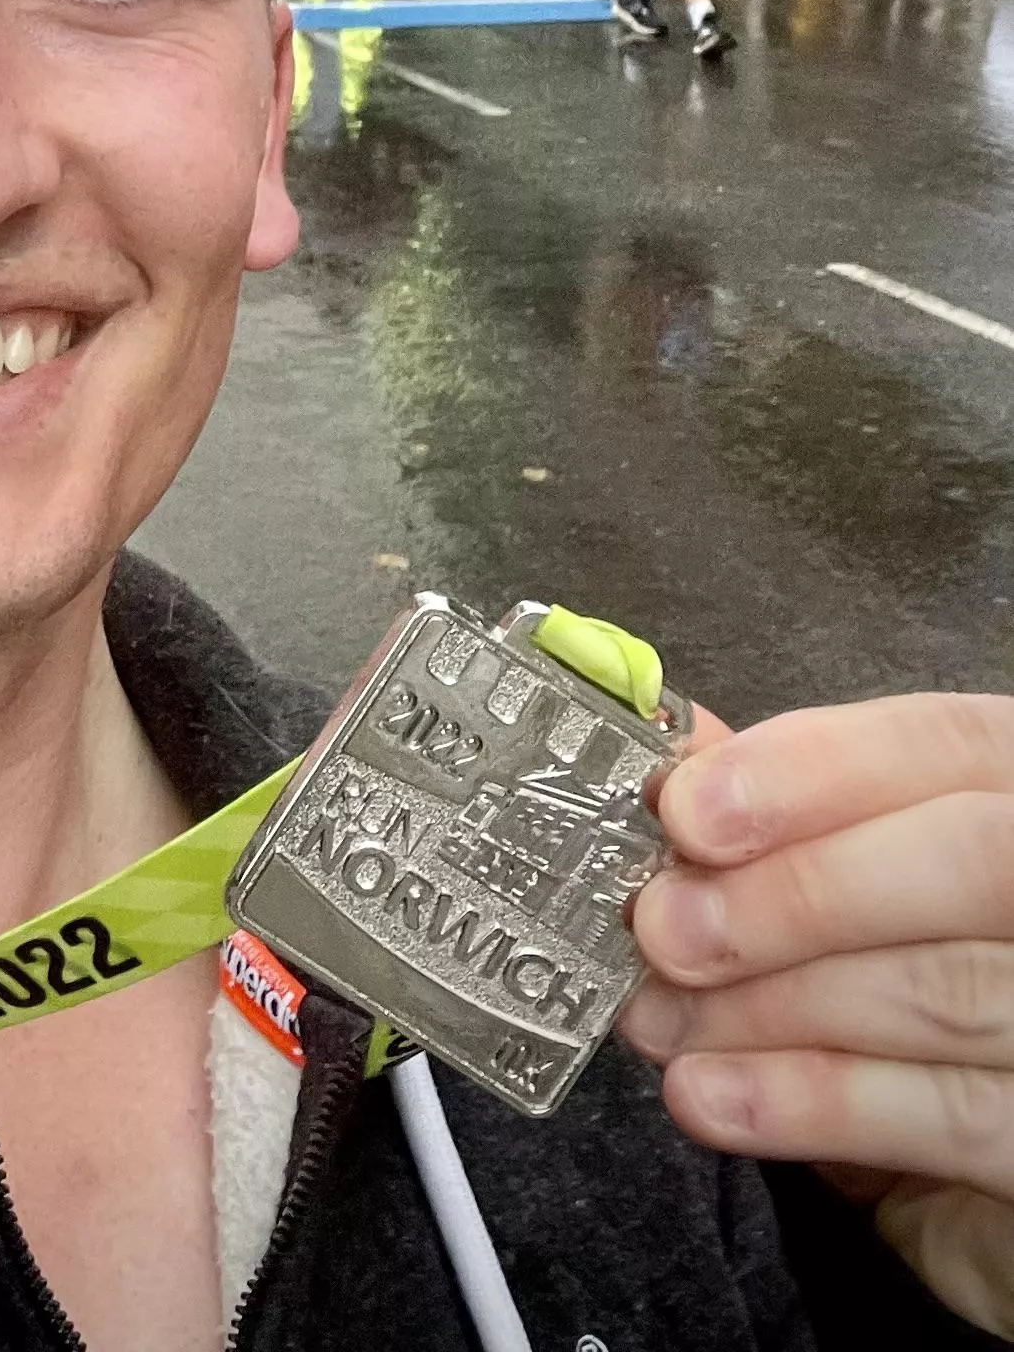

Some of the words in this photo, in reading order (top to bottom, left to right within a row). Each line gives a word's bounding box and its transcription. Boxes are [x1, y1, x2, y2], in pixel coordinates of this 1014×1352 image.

[379, 680, 483, 782] 2022
[323, 767, 433, 860] RUN
[299, 810, 598, 1031] NORWICH
